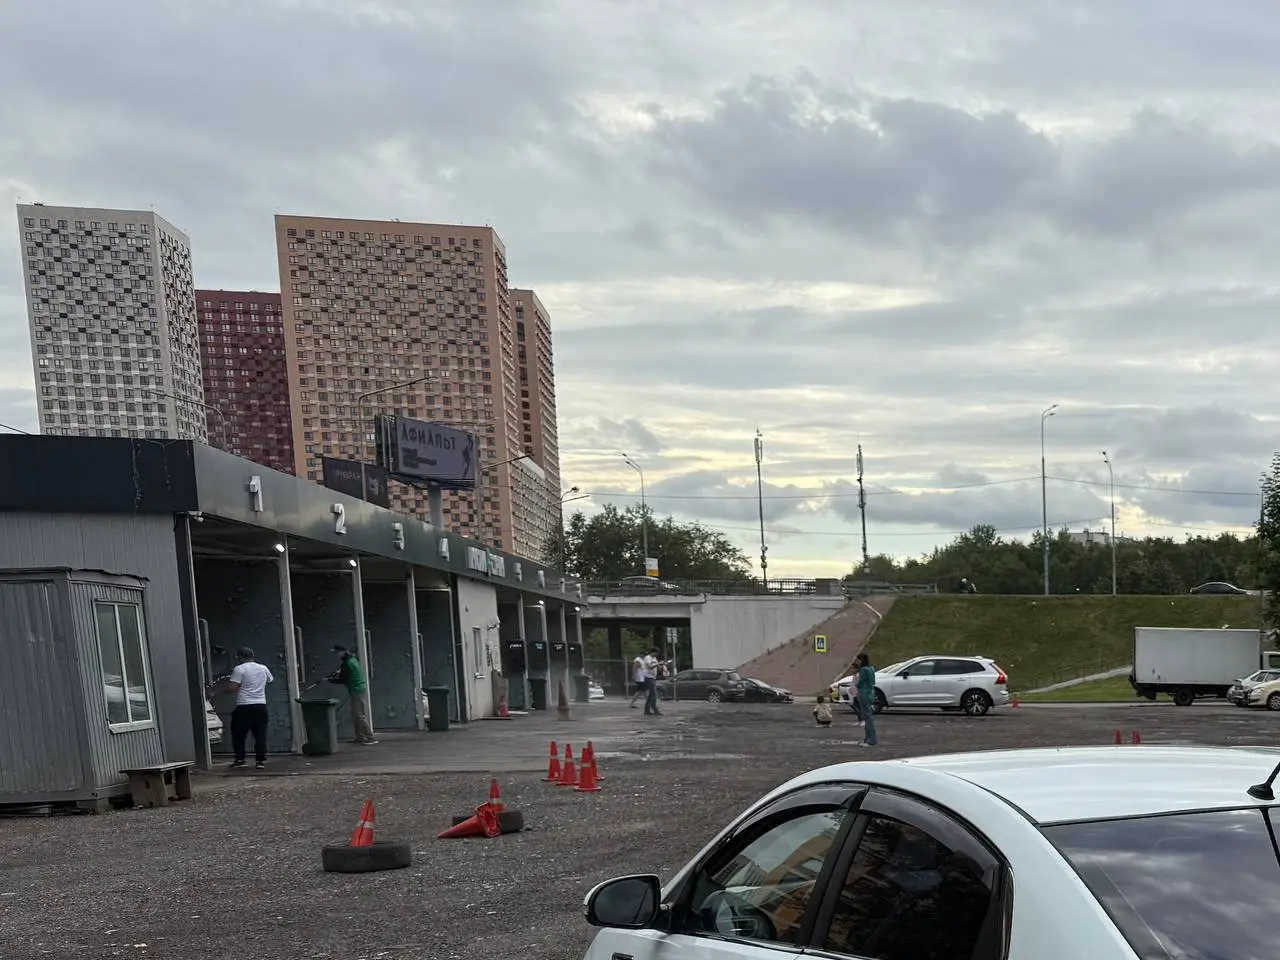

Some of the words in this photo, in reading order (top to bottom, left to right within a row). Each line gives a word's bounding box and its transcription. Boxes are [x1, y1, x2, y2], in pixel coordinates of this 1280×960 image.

[249, 475, 264, 513] 1
[333, 503, 347, 535] 2
[391, 522, 405, 551] 3
